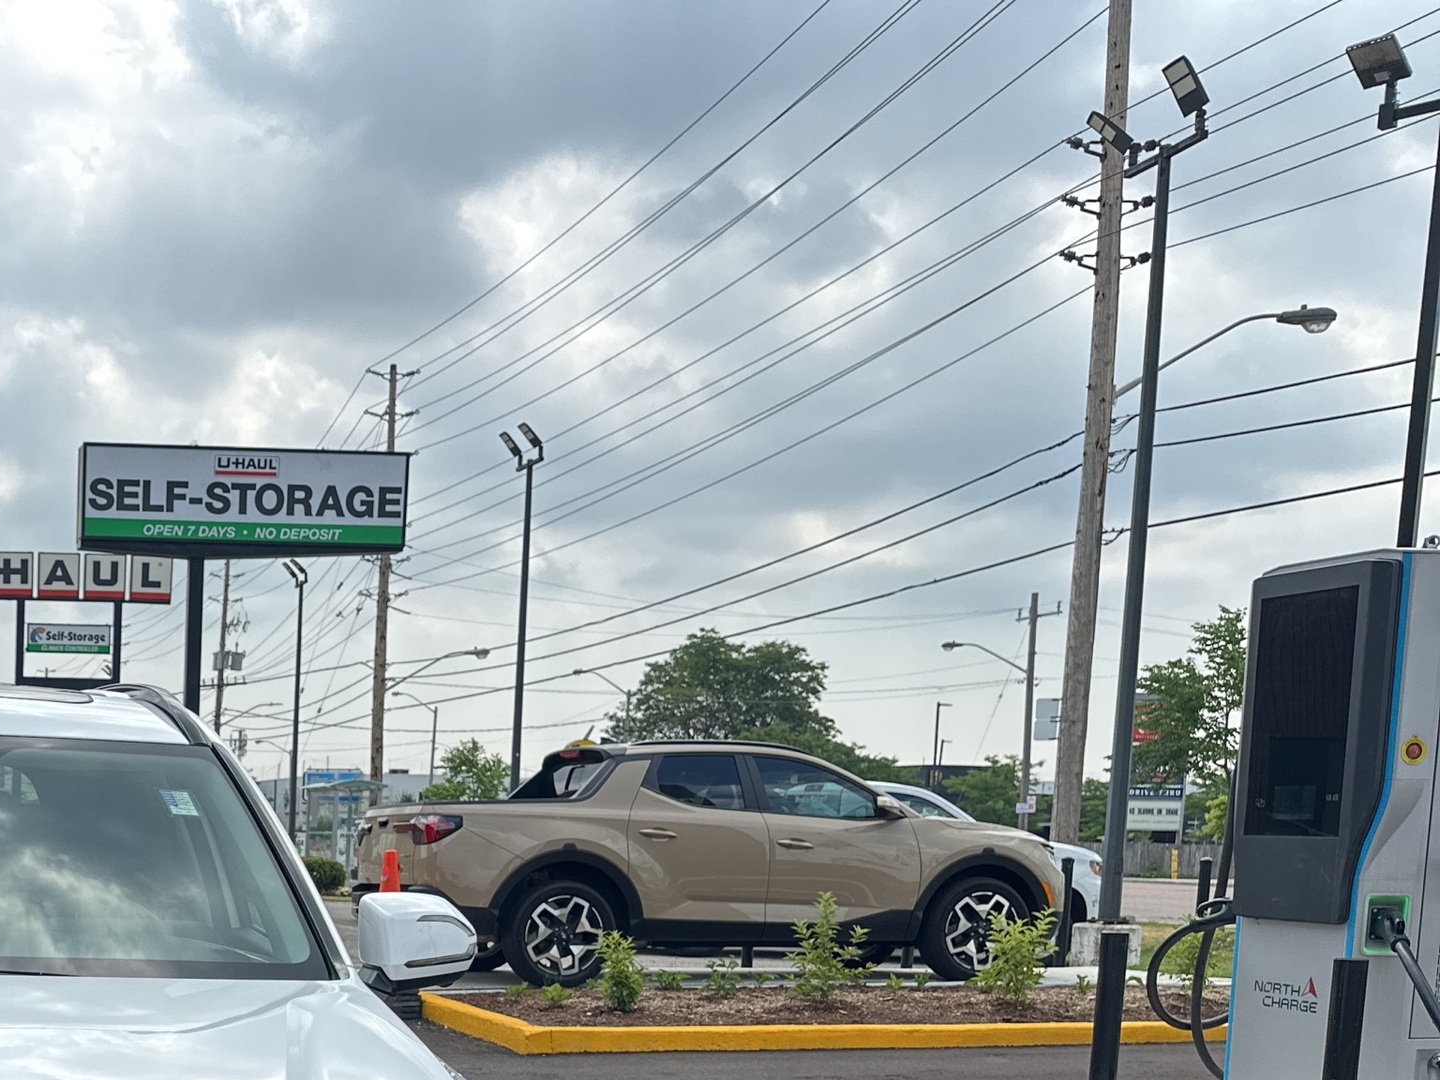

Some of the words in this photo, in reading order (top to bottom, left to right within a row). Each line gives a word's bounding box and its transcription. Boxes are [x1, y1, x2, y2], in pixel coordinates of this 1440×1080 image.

[88, 477, 403, 519] SELF-STORAGE
[143, 524, 182, 536] OPEN
[187, 525, 195, 537] 7
[197, 525, 236, 538] DAYS
[254, 527, 277, 540] NO
[279, 527, 343, 541] DEPOSIT
[46, 631, 106, 644] Self-Storage
[1254, 980, 1301, 996] NORTH
[1262, 996, 1318, 1014] CHARGE
